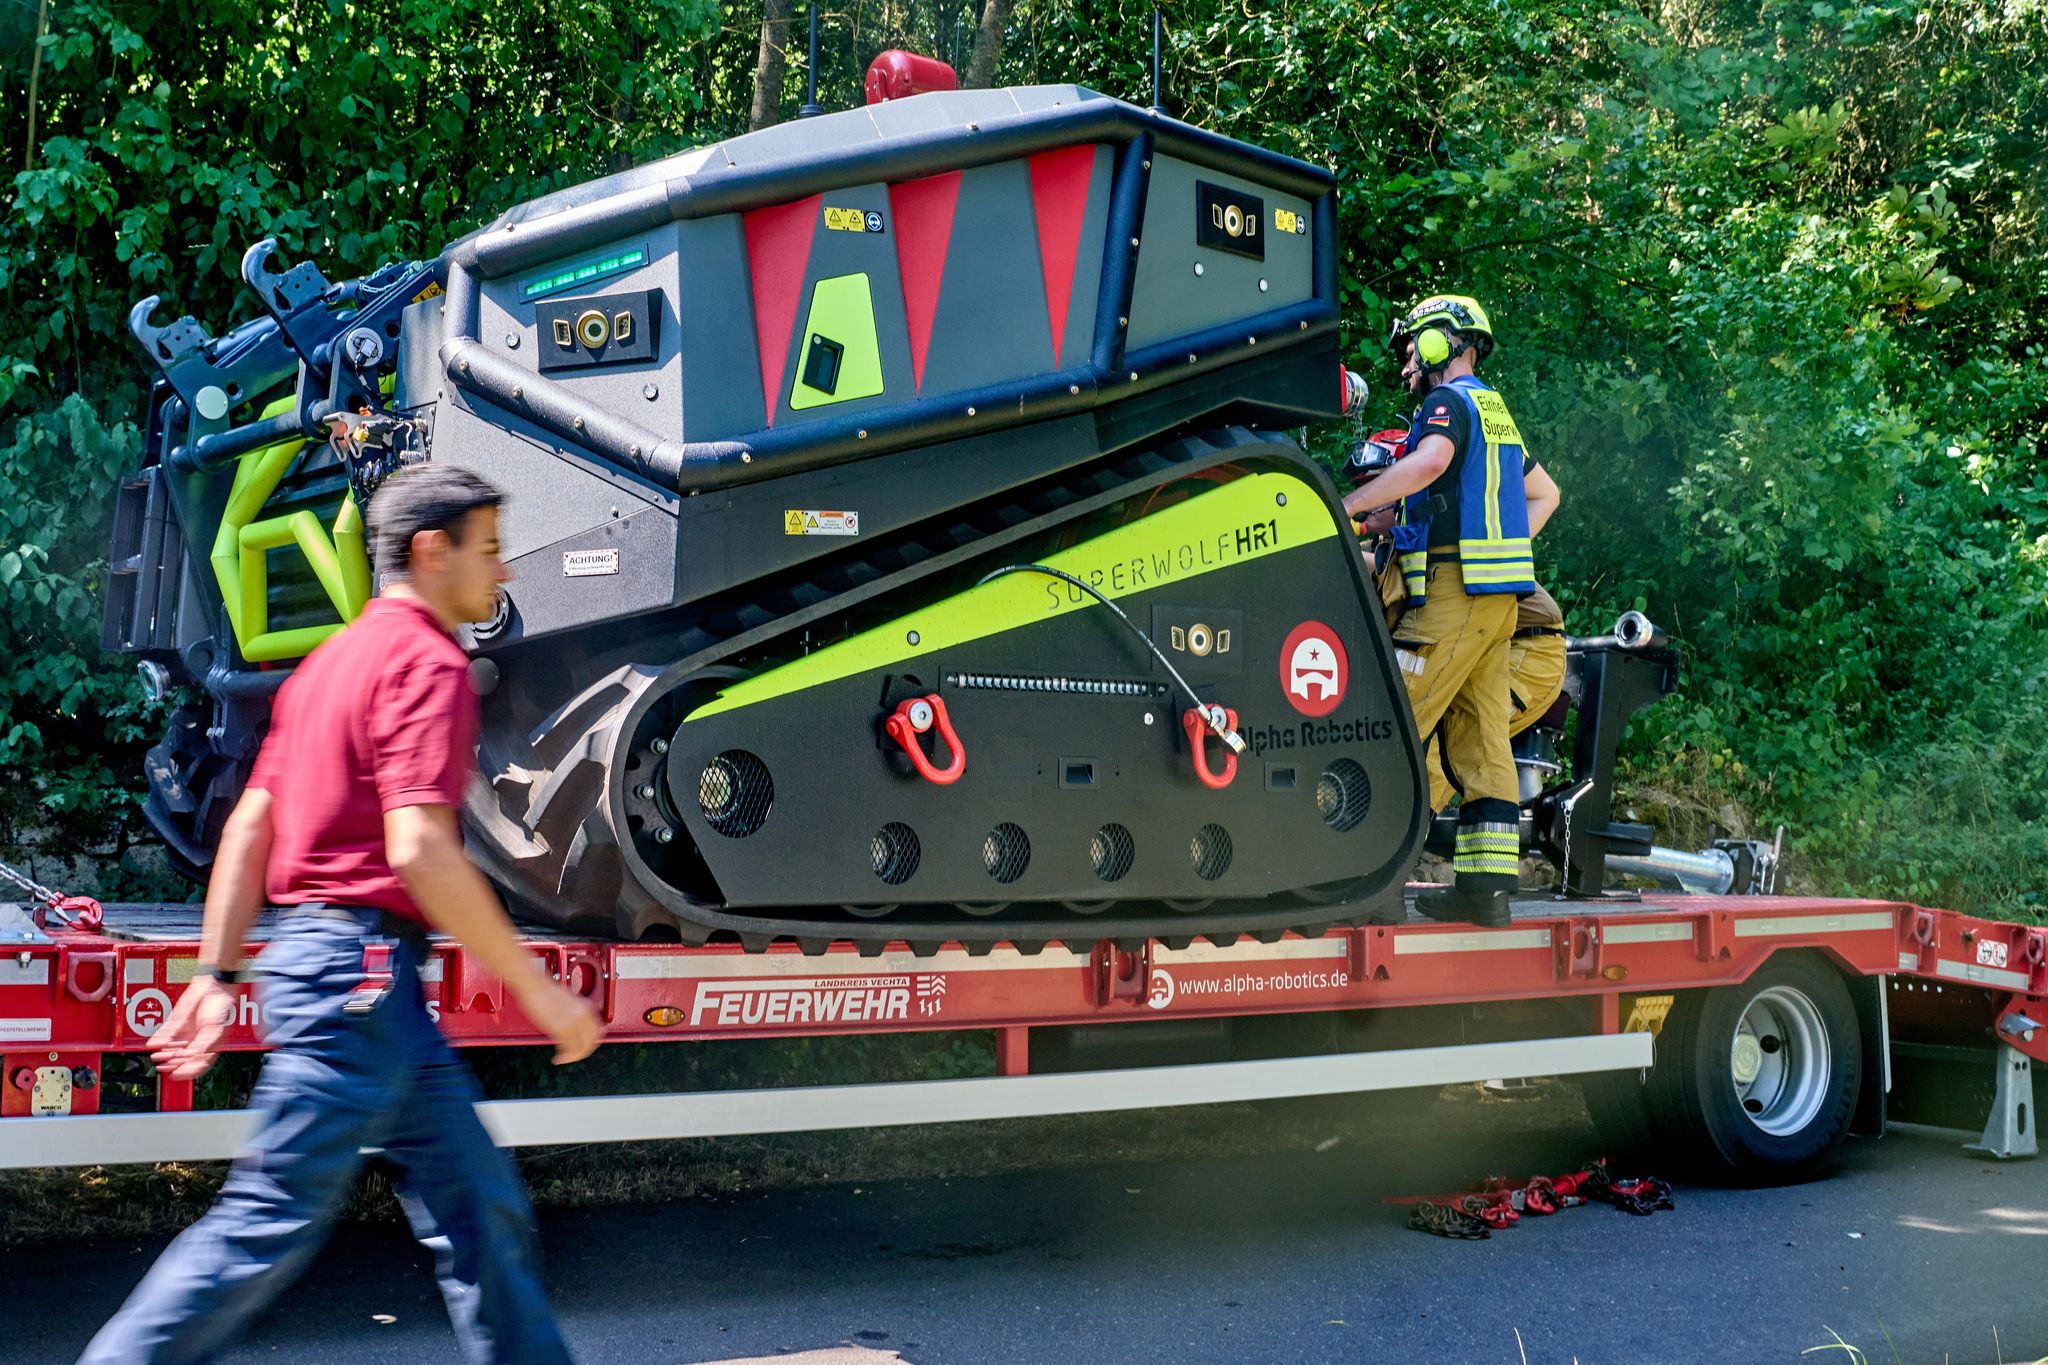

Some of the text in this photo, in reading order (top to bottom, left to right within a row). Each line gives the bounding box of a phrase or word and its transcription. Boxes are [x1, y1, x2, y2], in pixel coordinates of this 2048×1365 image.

[569, 554, 613, 565] ACHTUNG!
[1301, 716, 1393, 747] Robotics
[814, 978, 907, 988] LANDKREIS VECHTA
[1179, 968, 1349, 996] www.alpha-robotics.de
[689, 977, 910, 1026] FEUERWEHR
